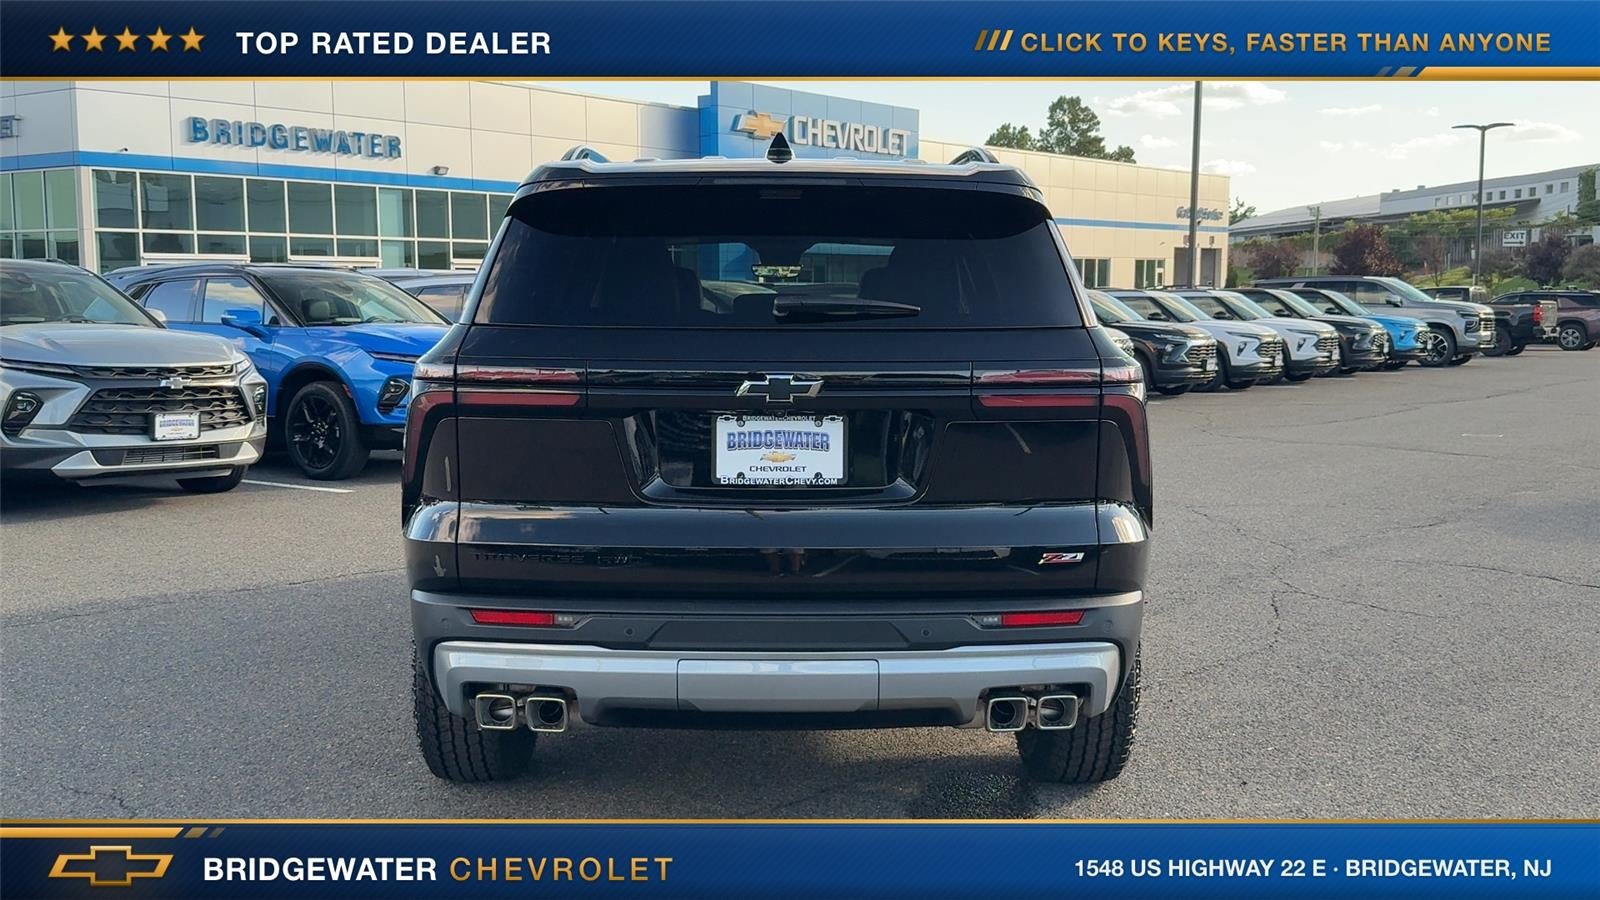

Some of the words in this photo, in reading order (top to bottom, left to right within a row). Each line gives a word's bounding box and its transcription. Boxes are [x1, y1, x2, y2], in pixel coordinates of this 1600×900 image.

[187, 116, 402, 160] BRIDGEWATER
[792, 115, 910, 156] CHEVROLET
[1504, 232, 1525, 240] EXIT
[727, 431, 830, 452] BRIDGEWATER
